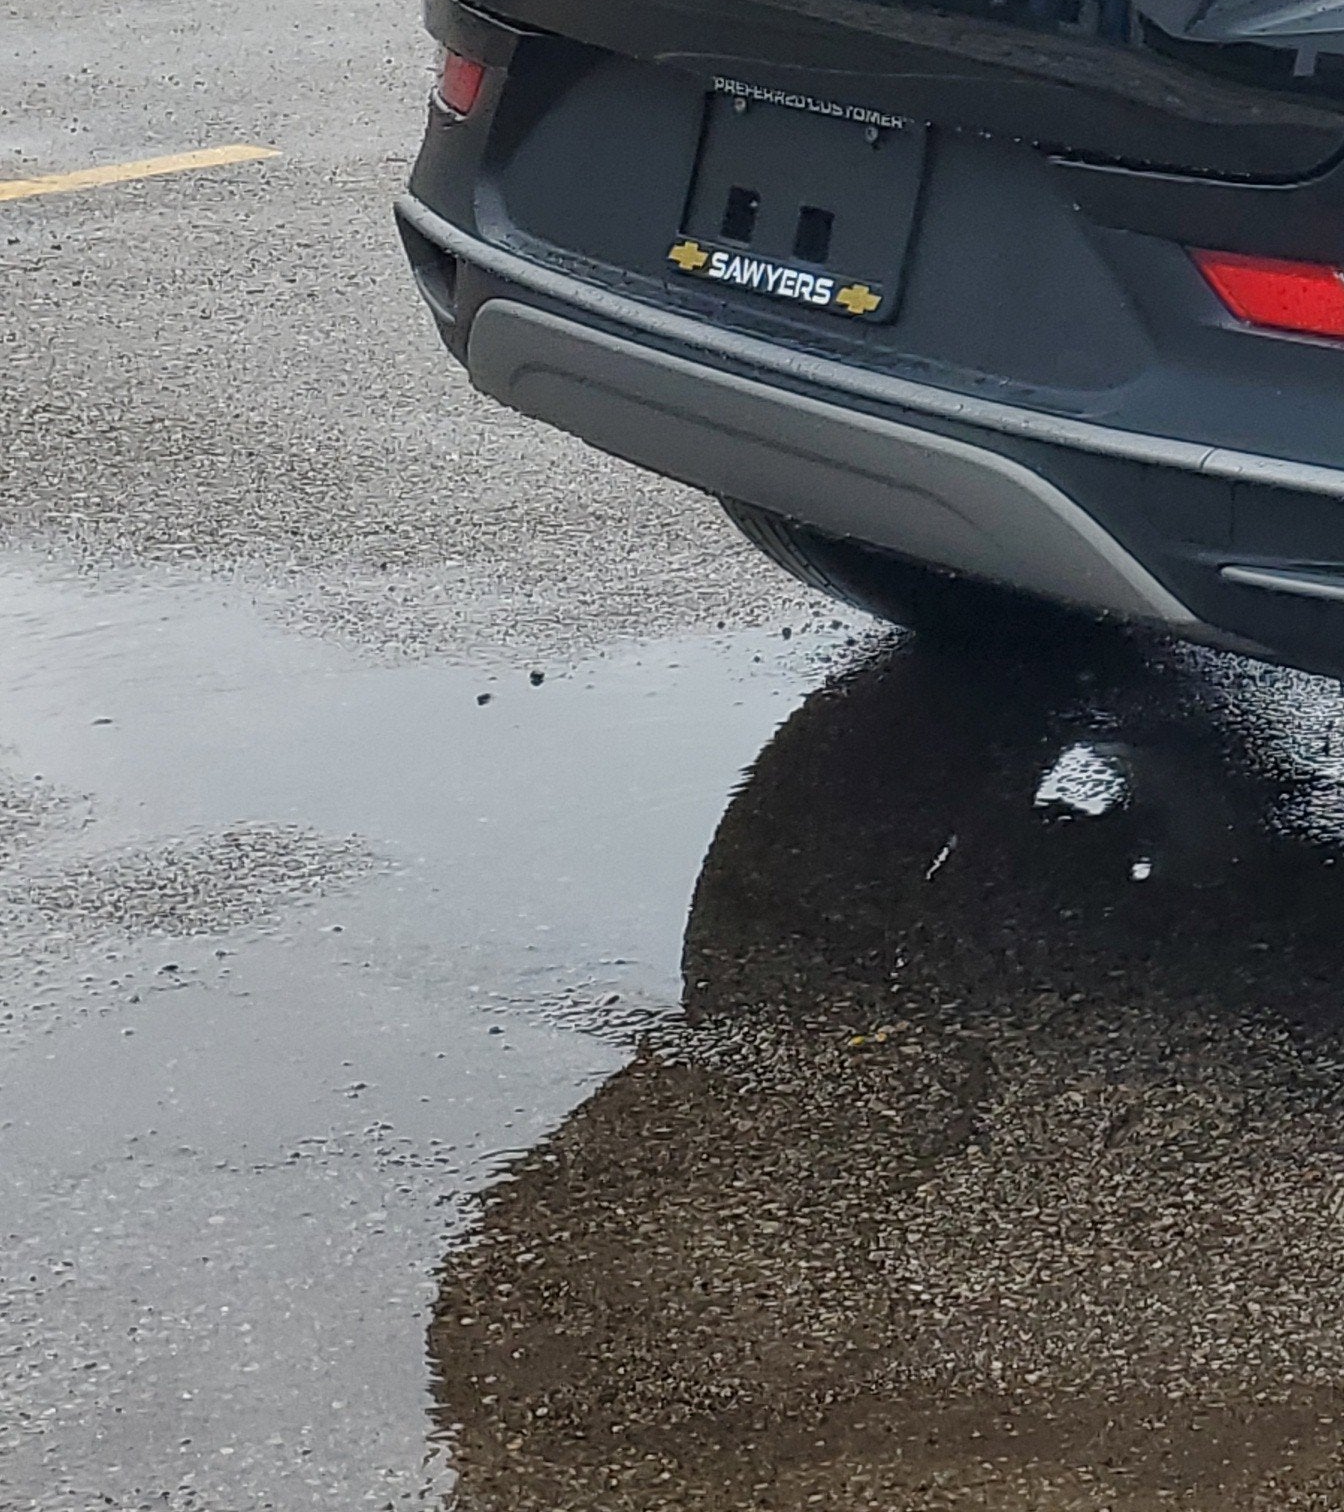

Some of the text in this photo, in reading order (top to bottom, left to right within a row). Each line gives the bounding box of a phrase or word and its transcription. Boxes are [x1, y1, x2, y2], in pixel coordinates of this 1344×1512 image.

[713, 76, 904, 129] PREFERRED CUSTOMER
[708, 251, 834, 305] SAWYERS
